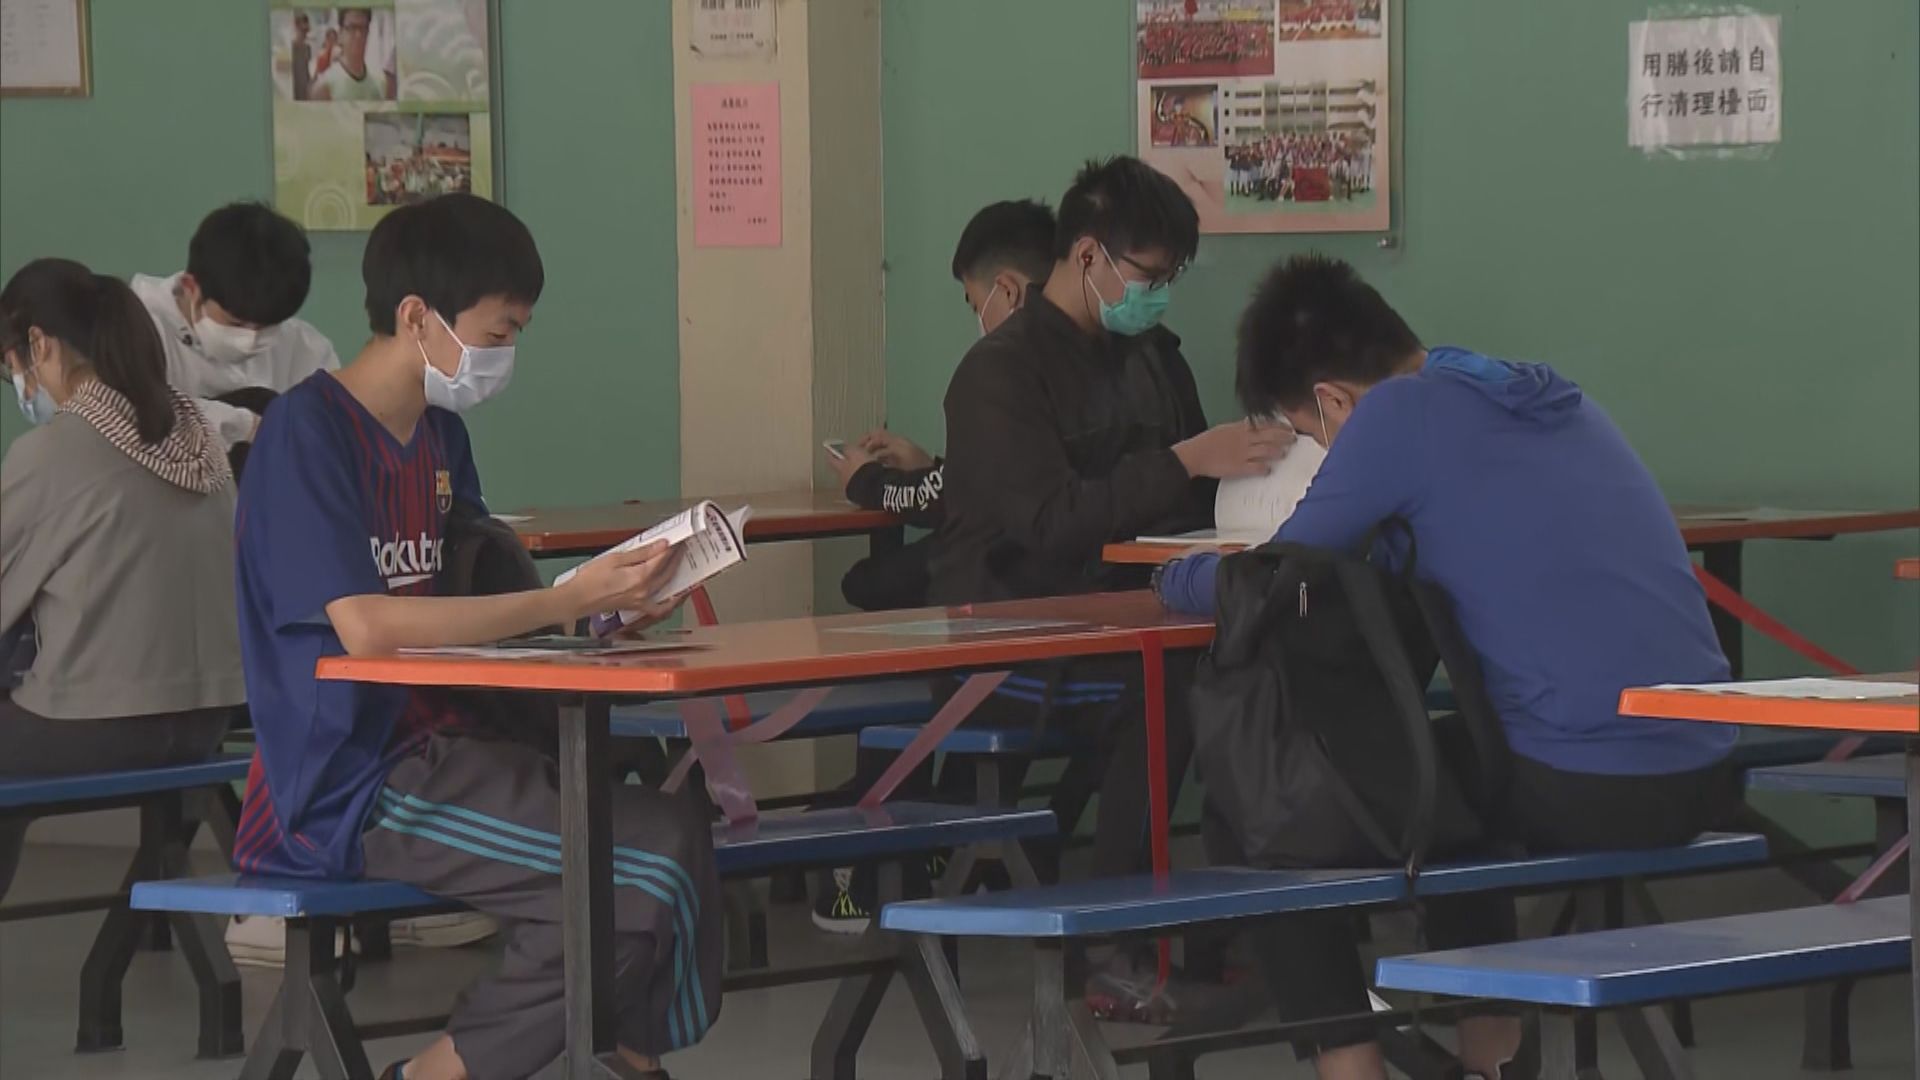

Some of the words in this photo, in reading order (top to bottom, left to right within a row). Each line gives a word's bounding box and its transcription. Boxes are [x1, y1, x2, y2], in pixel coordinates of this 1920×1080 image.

[1642, 46, 1765, 77] 用膳後請自
[1640, 87, 1768, 118] 行清理檯面
